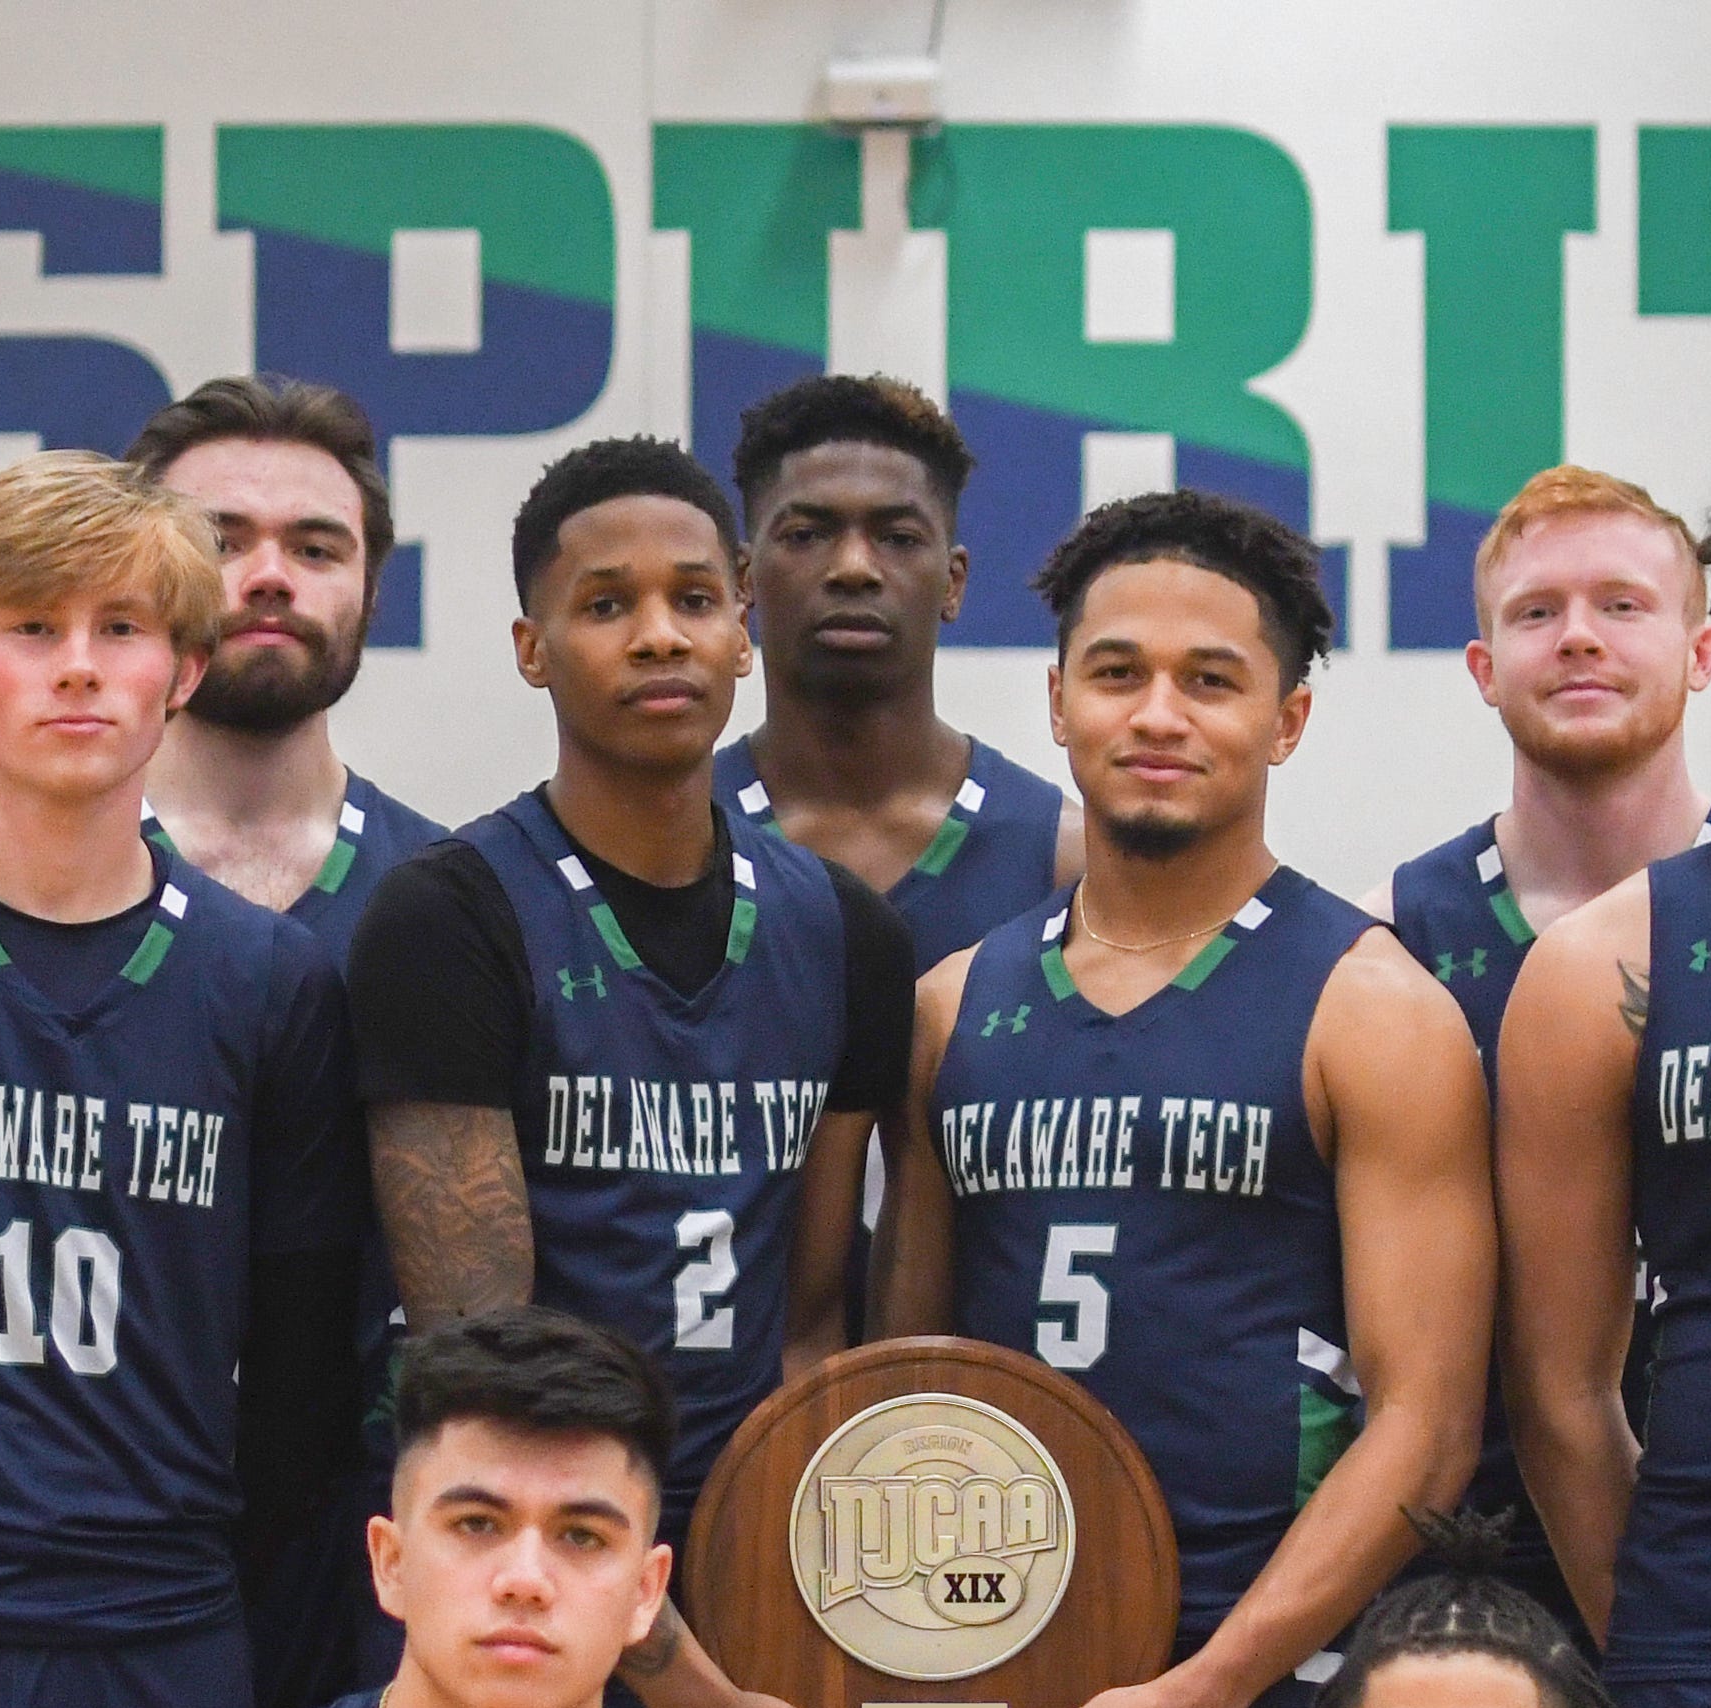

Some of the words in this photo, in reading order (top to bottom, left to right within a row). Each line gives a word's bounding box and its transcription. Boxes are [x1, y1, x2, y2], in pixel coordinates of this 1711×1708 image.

[127, 1103, 224, 1207] TECH
[544, 1075, 741, 1174] DELAWARE
[941, 1096, 1141, 1198] DELAWARE
[1158, 1097, 1273, 1198] TECH
[673, 1209, 738, 1351] 2
[1035, 1222, 1120, 1370] 5
[902, 1435, 975, 1456] REGION
[826, 1480, 1052, 1600] NJCAA
[943, 1572, 1007, 1604] XIX
